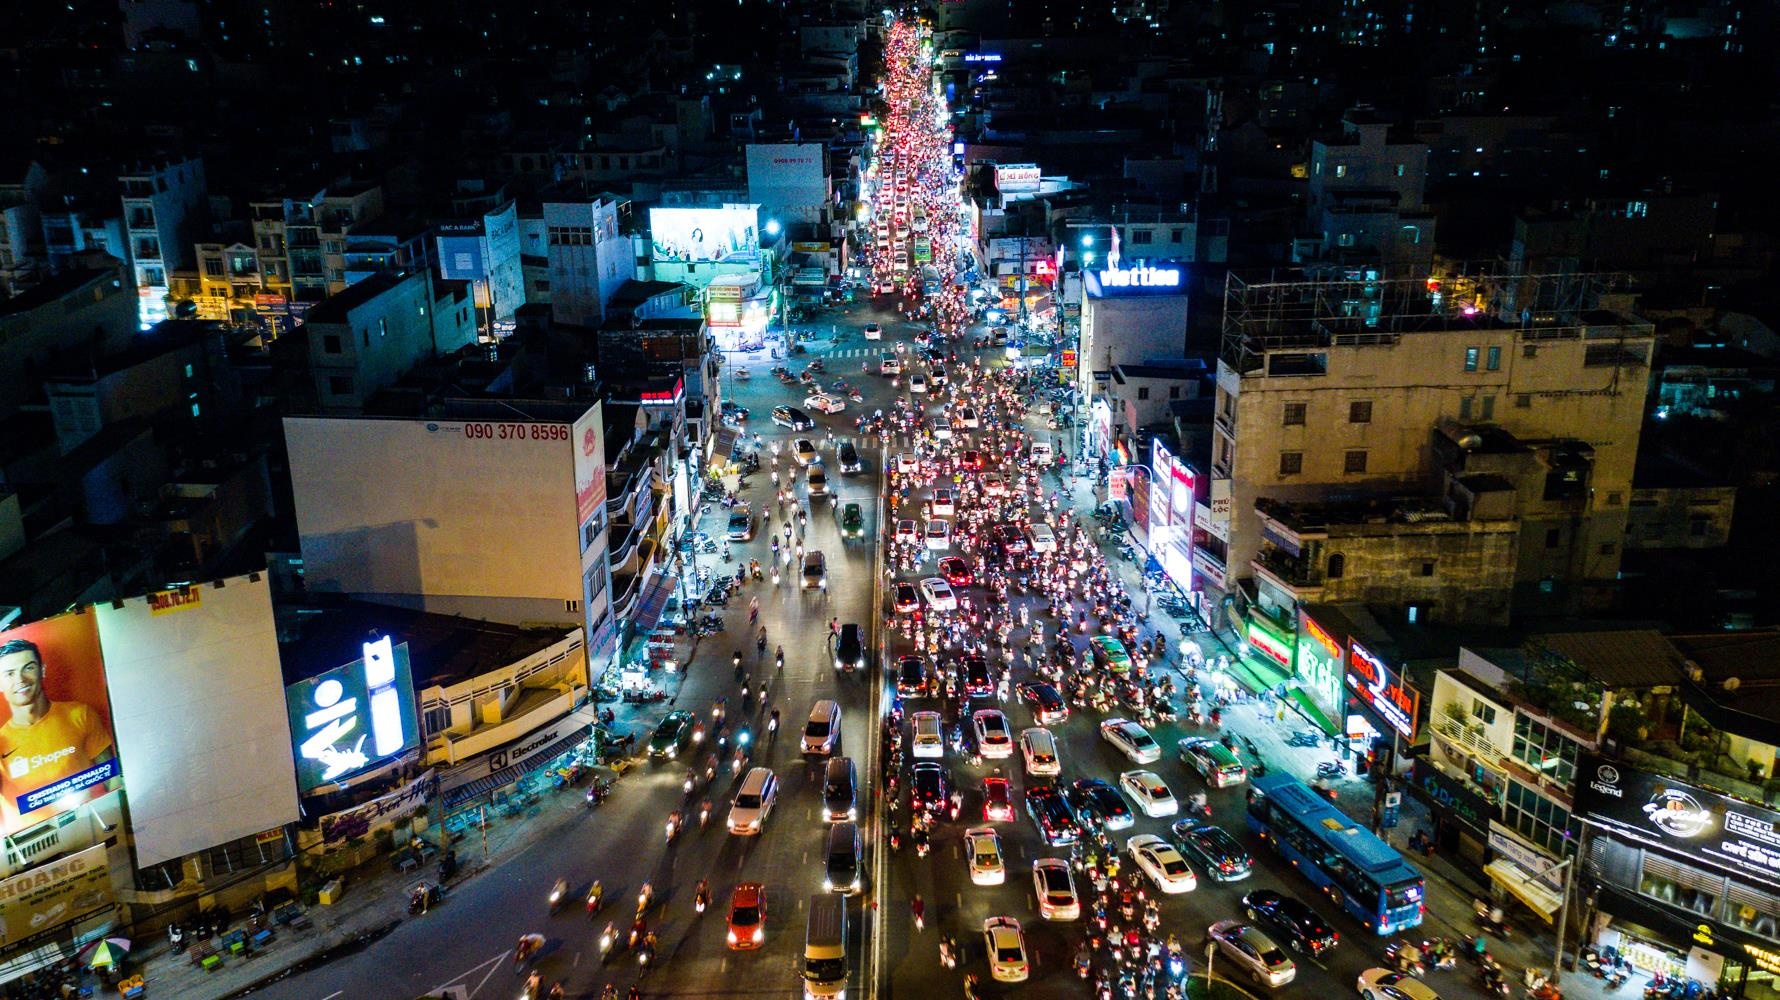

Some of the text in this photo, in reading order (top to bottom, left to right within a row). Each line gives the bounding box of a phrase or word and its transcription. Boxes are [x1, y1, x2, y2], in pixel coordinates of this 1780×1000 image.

[465, 423, 568, 440] 090 370 8596
[512, 731, 558, 759] Electrolux
[32, 746, 76, 769] Shopee
[27, 764, 111, 802] CRISTIANO RONALDO
[1590, 781, 1622, 798] Legend
